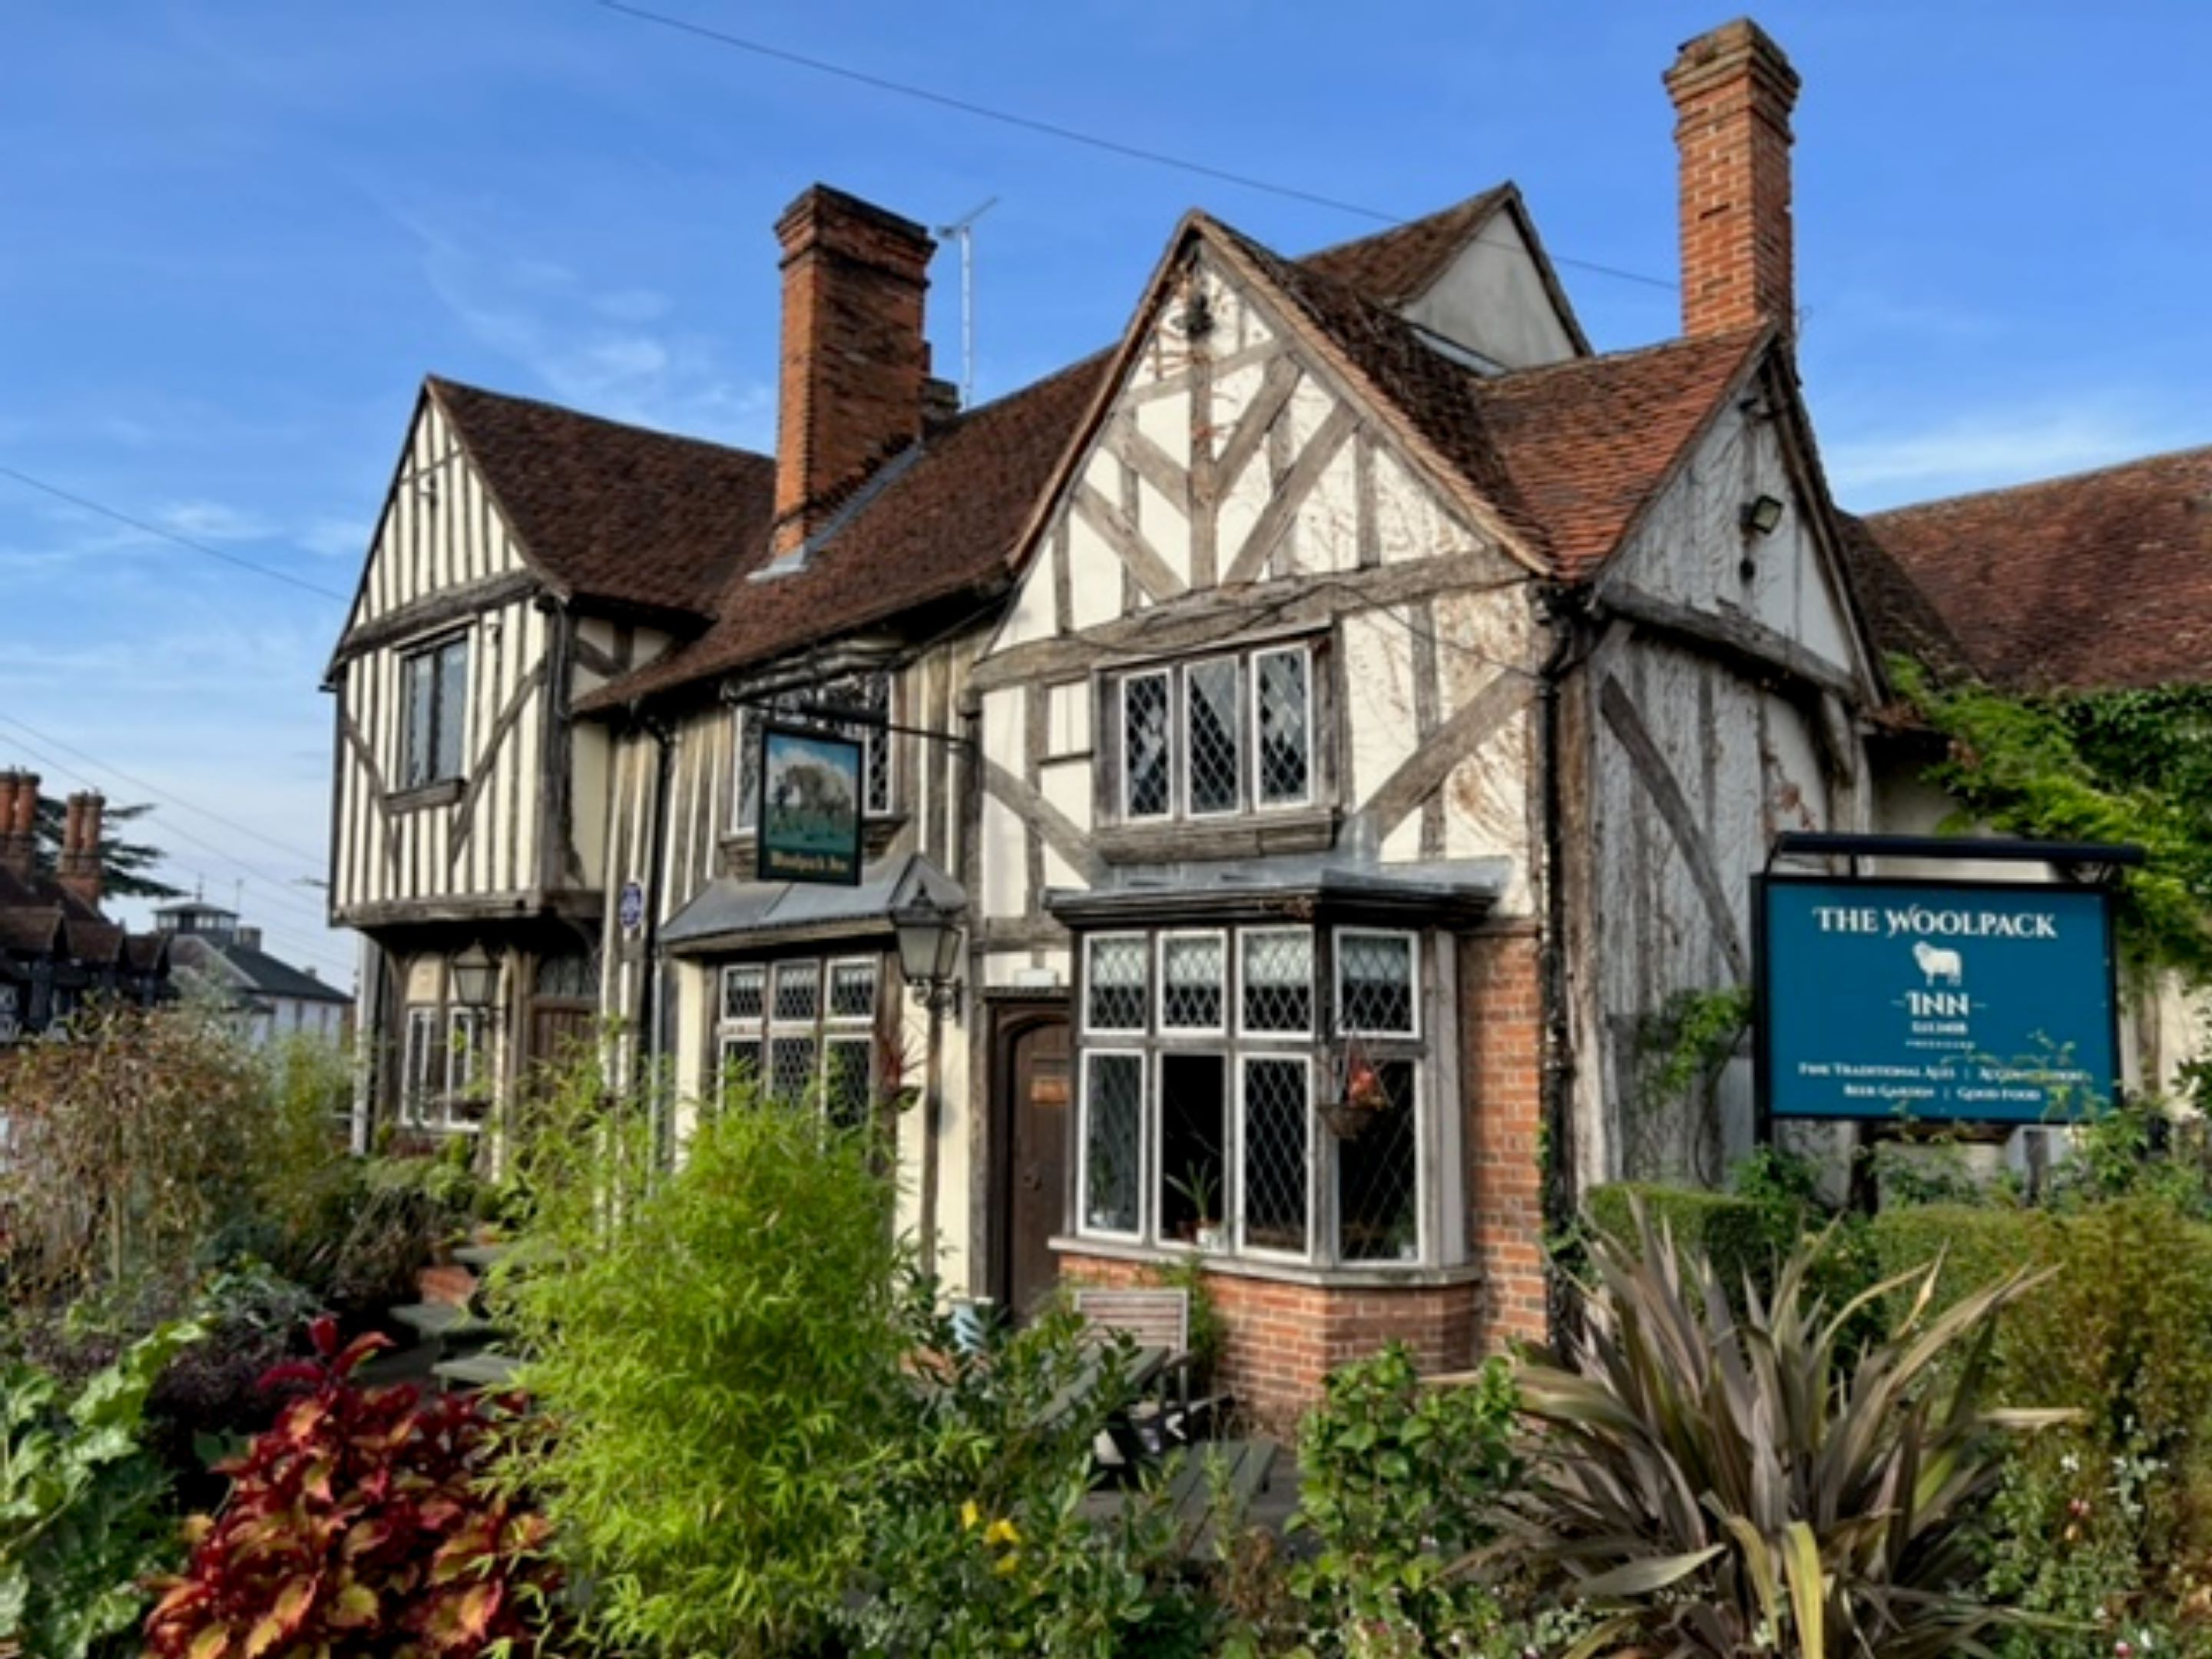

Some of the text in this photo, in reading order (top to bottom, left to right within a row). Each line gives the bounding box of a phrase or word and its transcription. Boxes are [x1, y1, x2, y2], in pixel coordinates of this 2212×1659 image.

[1813, 903, 2058, 939] THE WOOLPACK
[1905, 991, 1969, 1016] INN
